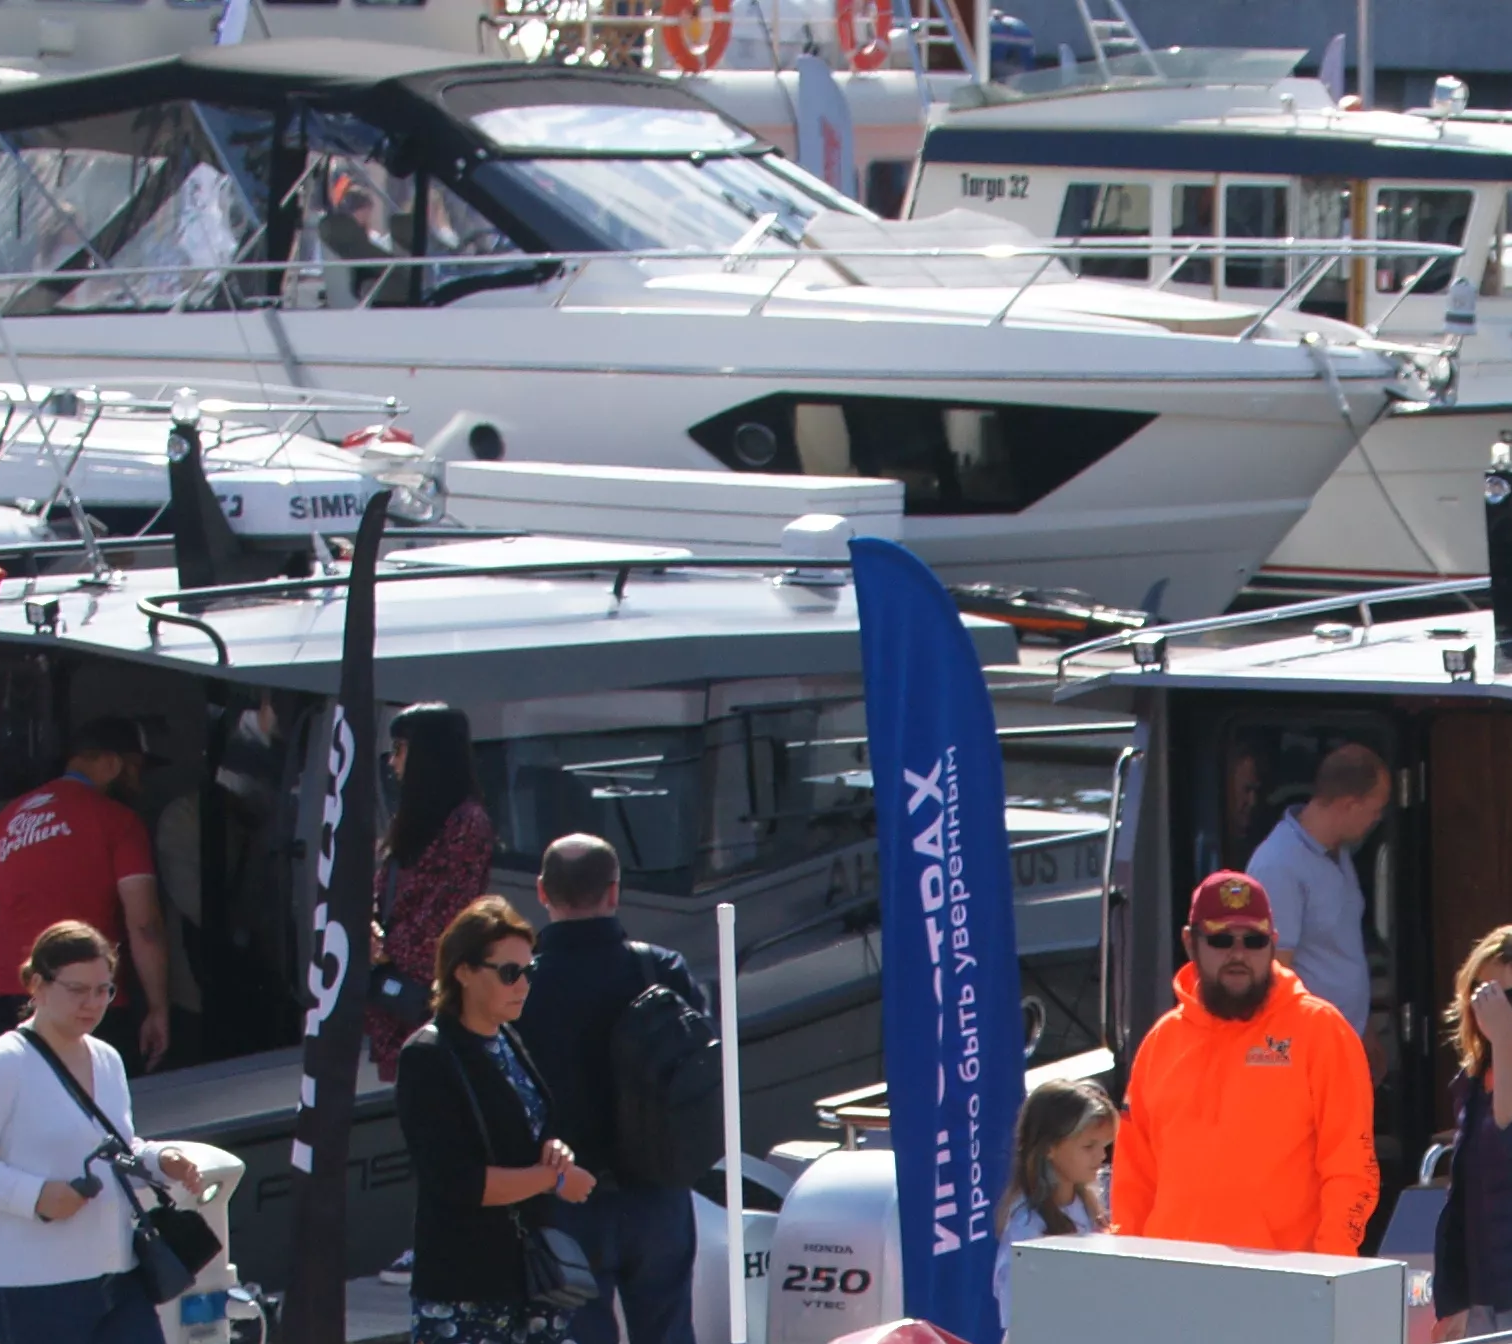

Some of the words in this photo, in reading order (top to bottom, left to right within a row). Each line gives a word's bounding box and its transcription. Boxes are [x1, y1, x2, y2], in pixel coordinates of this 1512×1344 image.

[1009, 174, 1030, 199] 32
[944, 745, 979, 968] уверенным
[957, 983, 982, 1082] быть
[966, 1094, 991, 1243] Просто
[803, 1243, 854, 1254] HONDA
[782, 1264, 872, 1294] 250
[802, 1300, 847, 1311] VTEC
